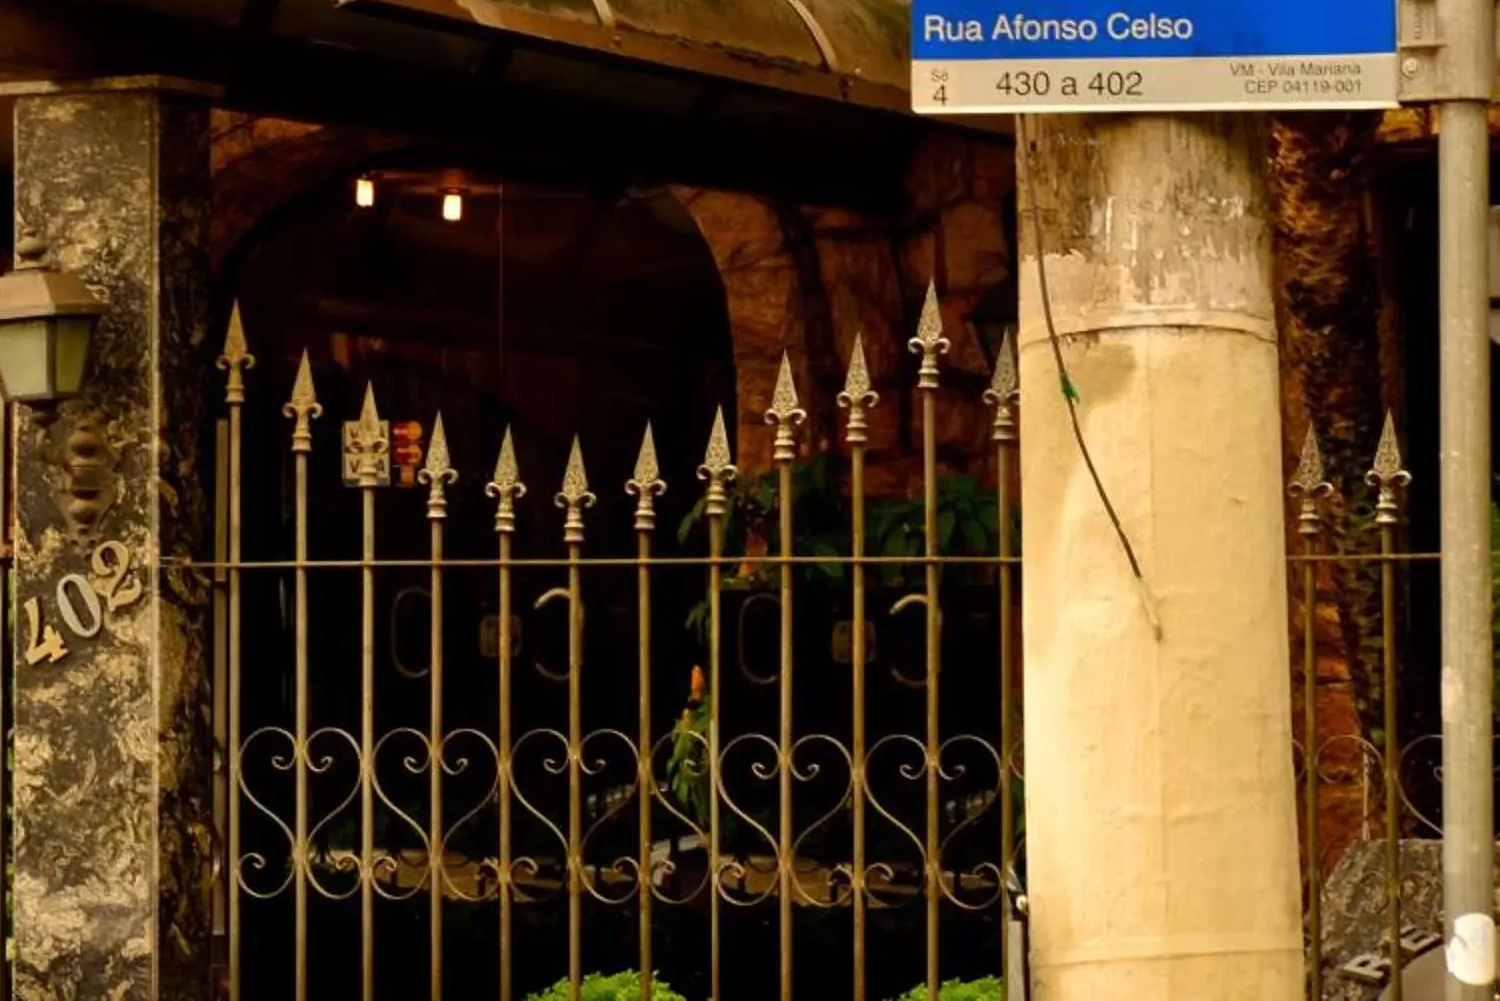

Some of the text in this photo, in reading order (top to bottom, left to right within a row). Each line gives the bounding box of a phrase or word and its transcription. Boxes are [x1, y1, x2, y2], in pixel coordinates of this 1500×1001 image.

[923, 11, 1194, 42] Rua Afonso Celso
[1229, 62, 1255, 77] VM
[1300, 61, 1362, 76] Mariana
[931, 83, 949, 107] 4
[995, 70, 1144, 96] 430 a 402
[1243, 78, 1279, 94] CEP
[23, 540, 143, 666] 402
